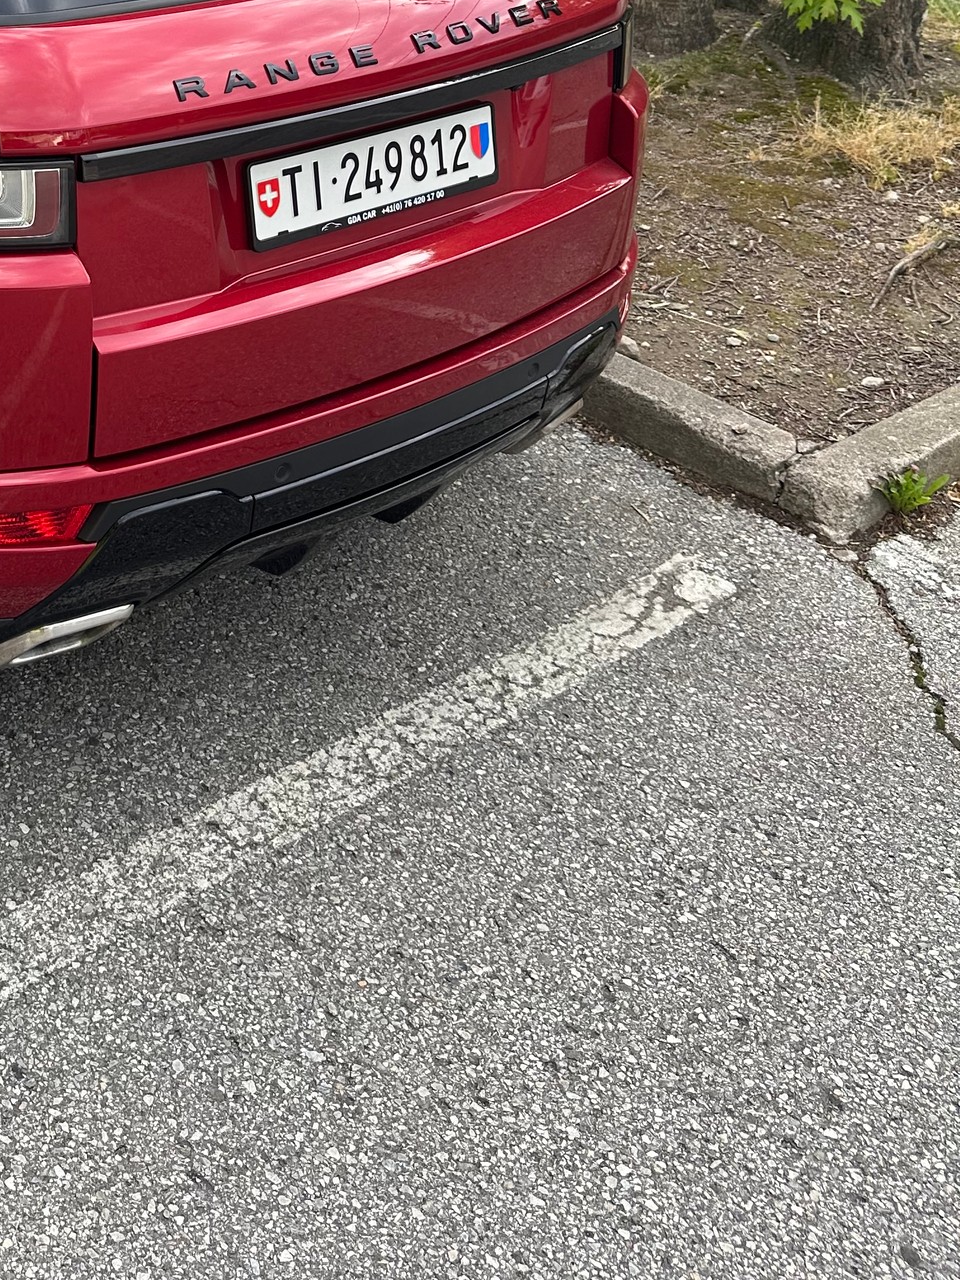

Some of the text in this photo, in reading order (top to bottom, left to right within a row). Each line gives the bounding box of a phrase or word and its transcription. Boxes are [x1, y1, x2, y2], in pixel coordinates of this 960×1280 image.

[172, 43, 379, 102] RANGE
[347, 189, 445, 225] GDA CAR +41(0) 76 420 17 00
